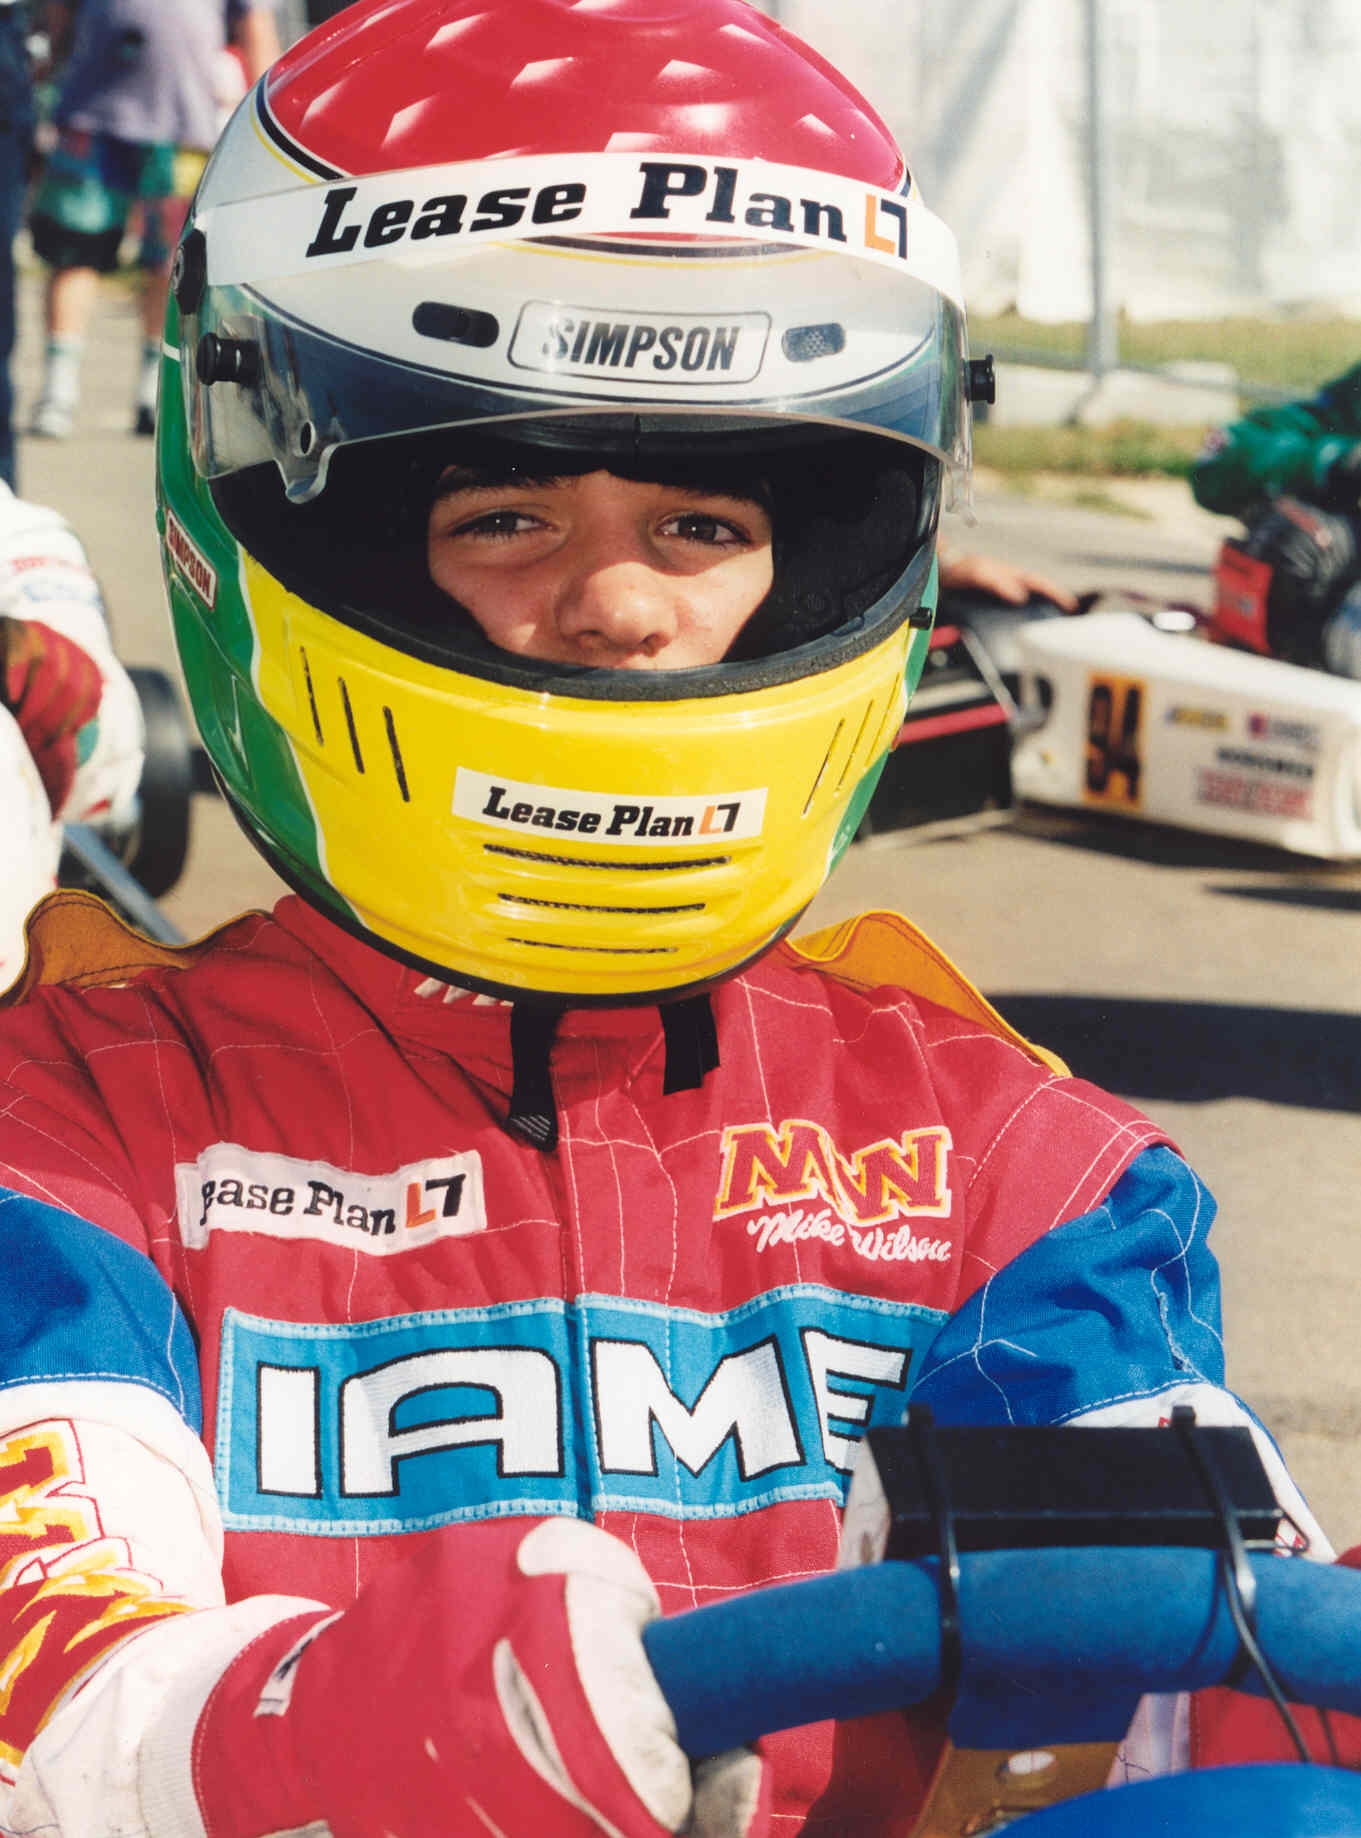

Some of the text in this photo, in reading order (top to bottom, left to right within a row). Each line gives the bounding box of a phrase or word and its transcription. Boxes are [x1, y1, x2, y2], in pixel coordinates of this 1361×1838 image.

[305, 183, 587, 258] Lease
[629, 161, 848, 243] Plan
[541, 316, 741, 372] SIMPSON
[482, 785, 602, 834] Lease
[605, 804, 695, 838] Plan
[303, 1179, 396, 1236] Plan
[746, 1208, 848, 1254] Mike
[256, 1326, 913, 1499] IAME
